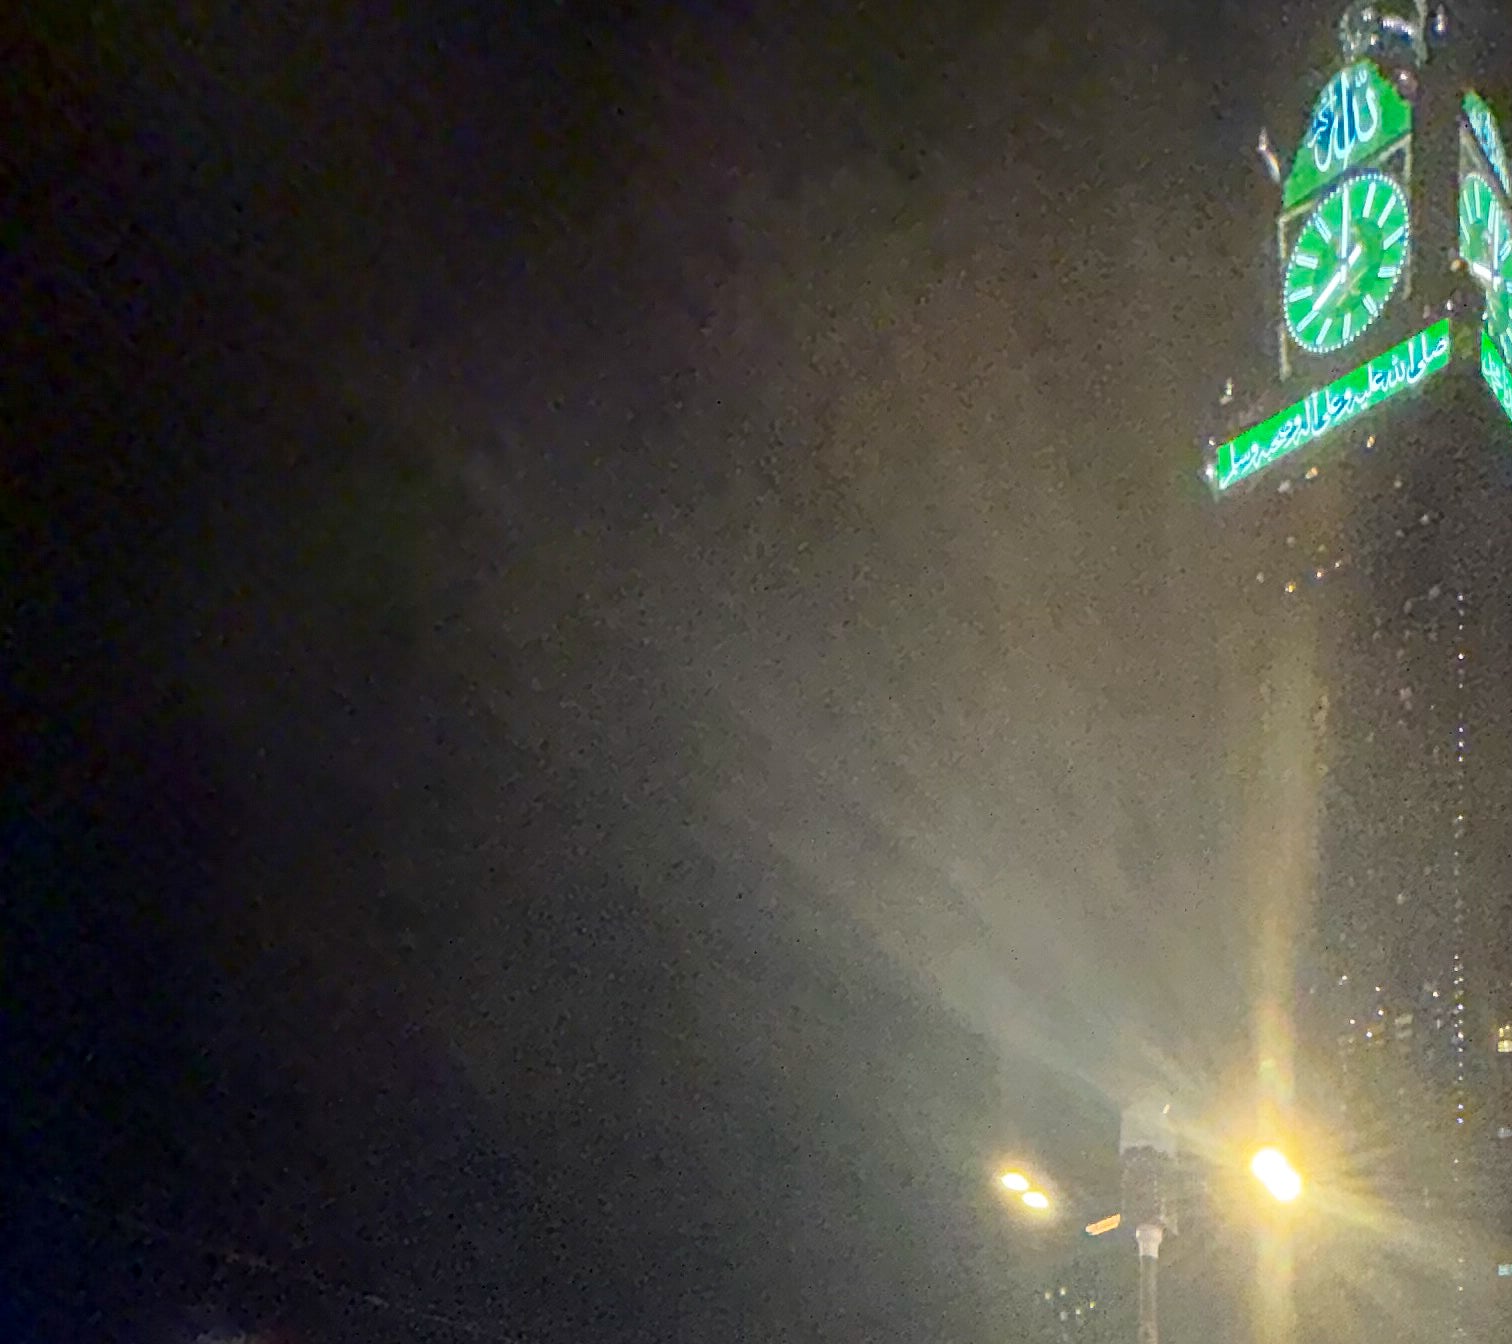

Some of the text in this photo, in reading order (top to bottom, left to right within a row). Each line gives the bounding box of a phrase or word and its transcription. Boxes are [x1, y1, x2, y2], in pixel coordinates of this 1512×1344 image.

[1407, 331, 1449, 384] صلى
[1353, 363, 1384, 409] عليه
[1311, 388, 1352, 435] وعلى
[1219, 441, 1259, 489] وسلم
